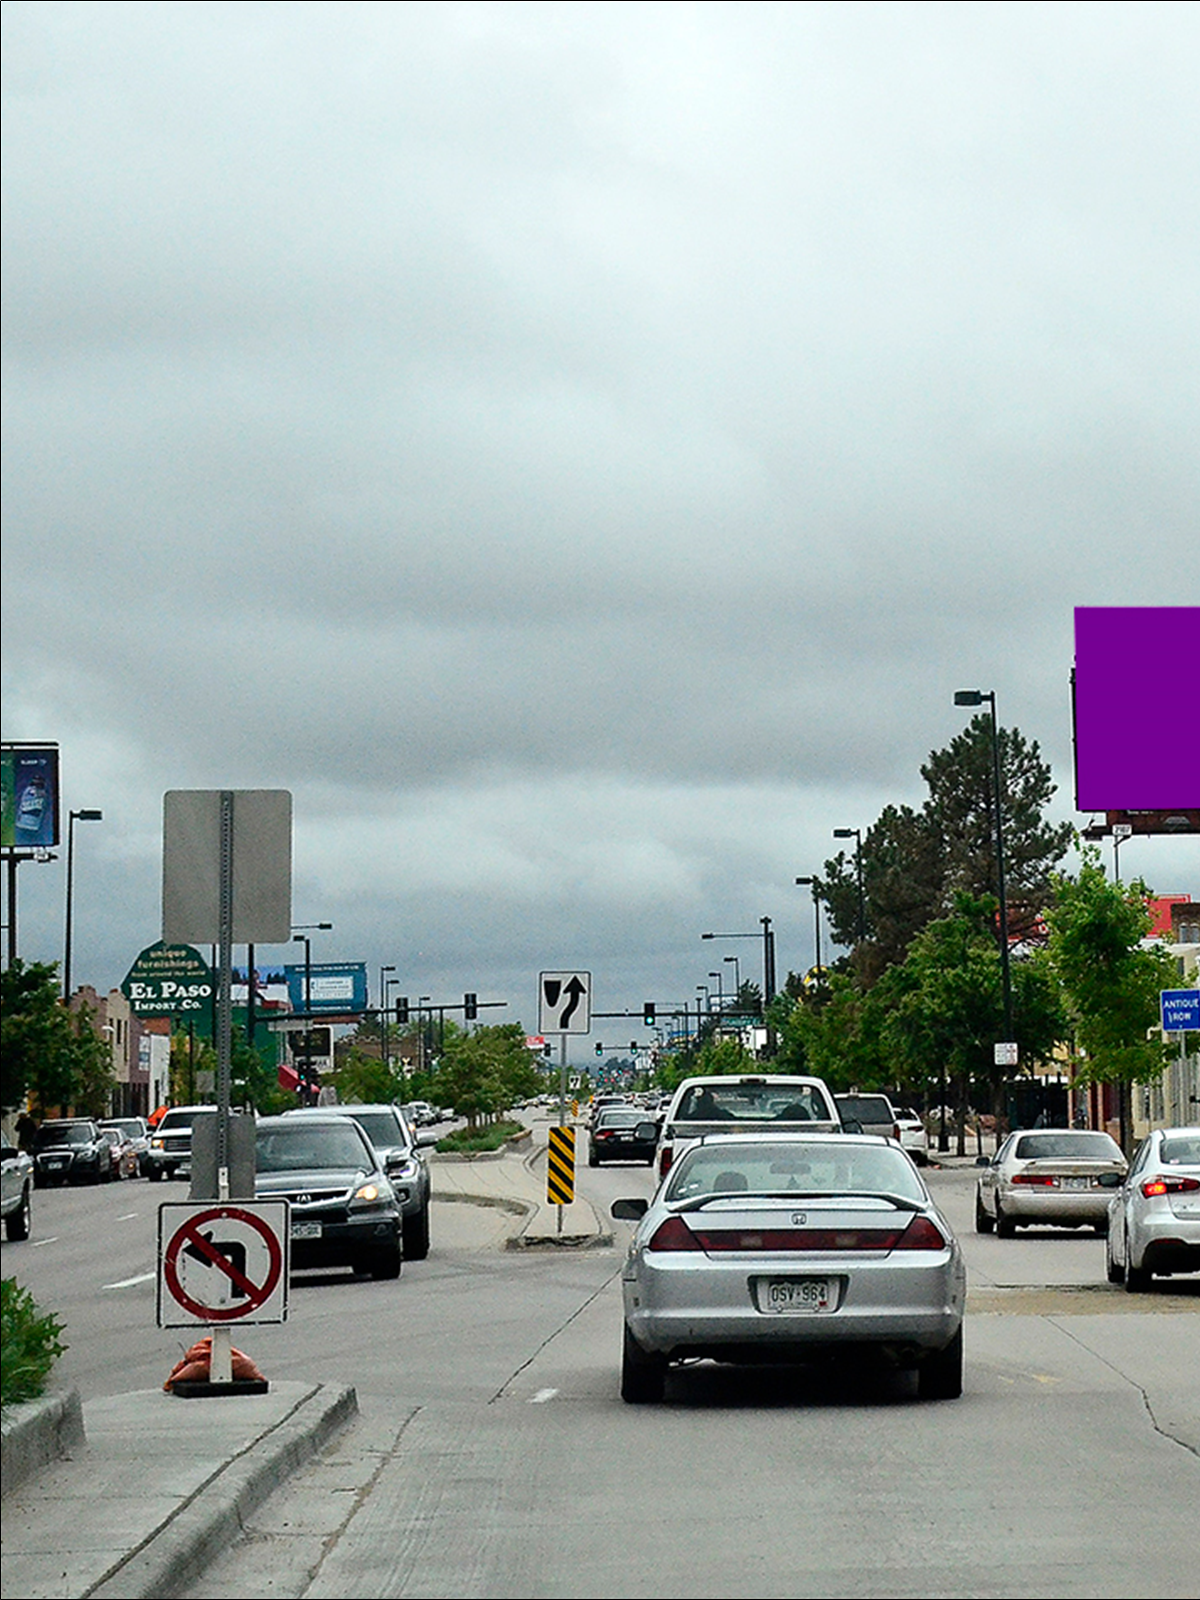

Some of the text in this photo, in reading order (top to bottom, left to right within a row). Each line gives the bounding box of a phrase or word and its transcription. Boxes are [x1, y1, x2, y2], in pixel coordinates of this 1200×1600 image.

[130, 982, 212, 999] EL PASO
[134, 1001, 177, 1010] IMPORT
[1163, 999, 1199, 1009] ANTIQUE
